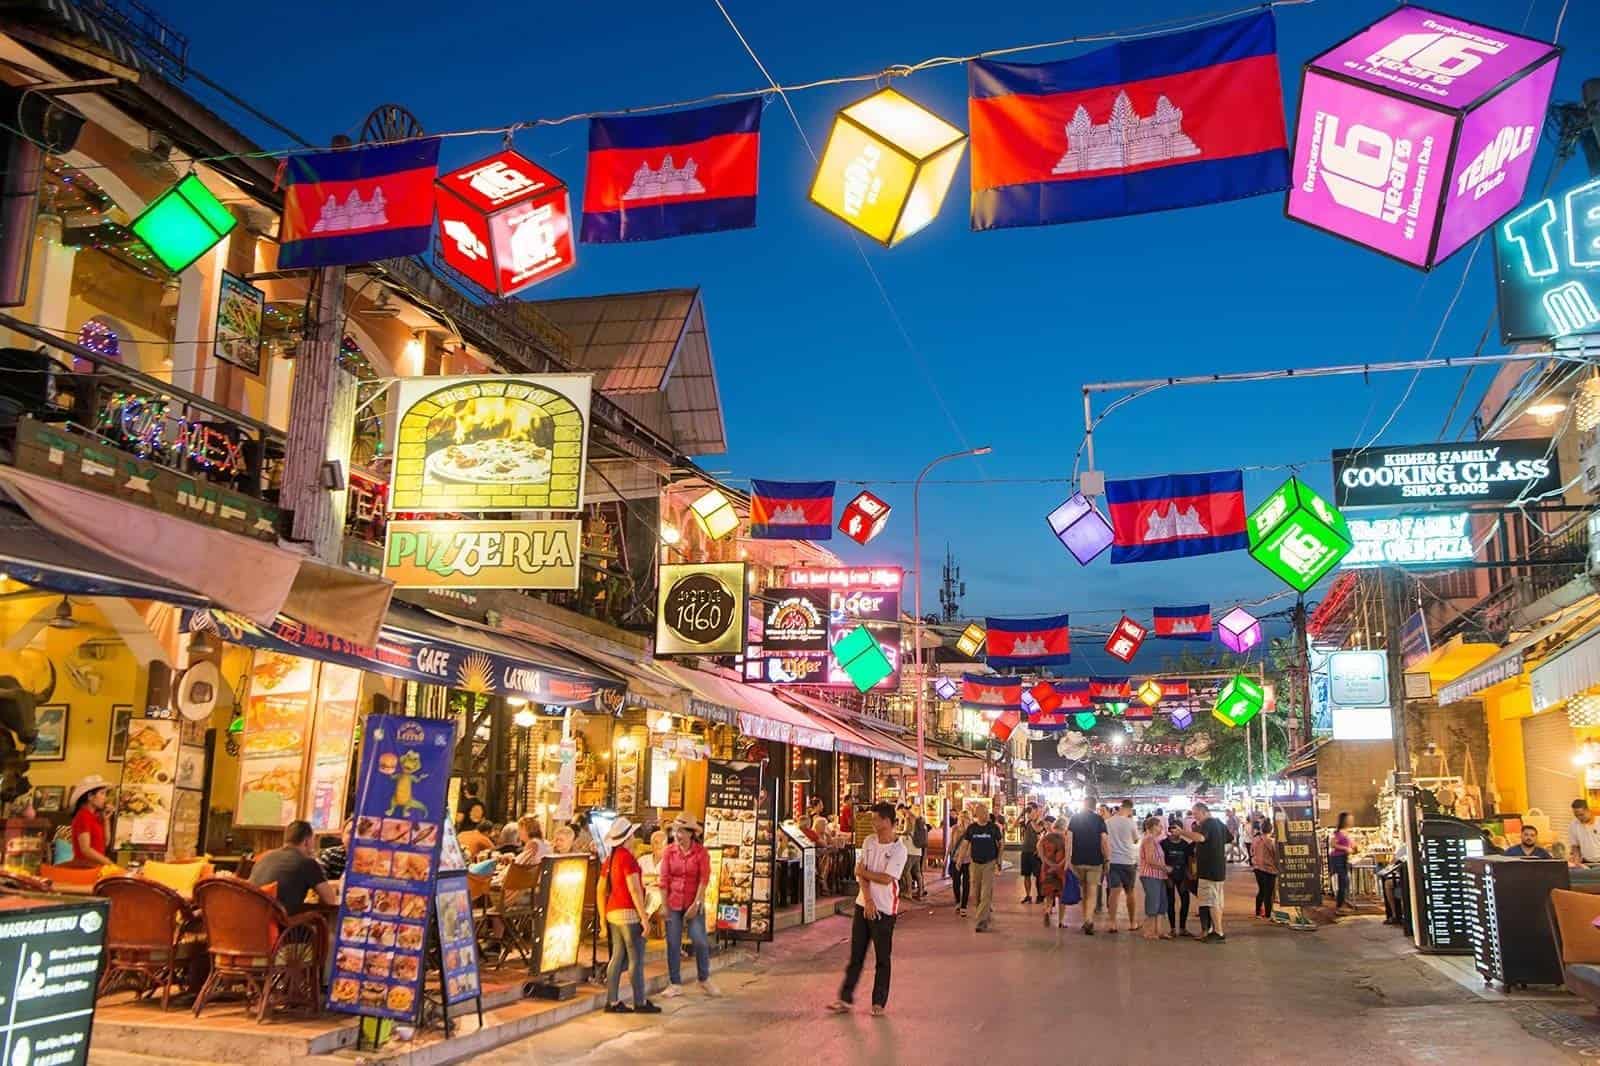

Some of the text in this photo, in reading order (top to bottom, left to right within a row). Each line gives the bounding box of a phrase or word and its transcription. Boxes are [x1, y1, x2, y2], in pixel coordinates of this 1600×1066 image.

[1365, 32, 1504, 76] 16
[1319, 114, 1394, 220] 16
[1381, 136, 1412, 224] years
[1456, 126, 1535, 197] TEMPLE
[1342, 458, 1550, 488] COOKING CLASS
[1440, 447, 1501, 465] FAMILY
[1402, 482, 1490, 497] SINCE 2002
[387, 530, 573, 577] PIZZERIA
[677, 602, 721, 632] 1960
[416, 647, 450, 677] CAFE
[503, 666, 542, 694] LATINO
[782, 656, 822, 679] Tiger
[47, 915, 79, 933] MENU
